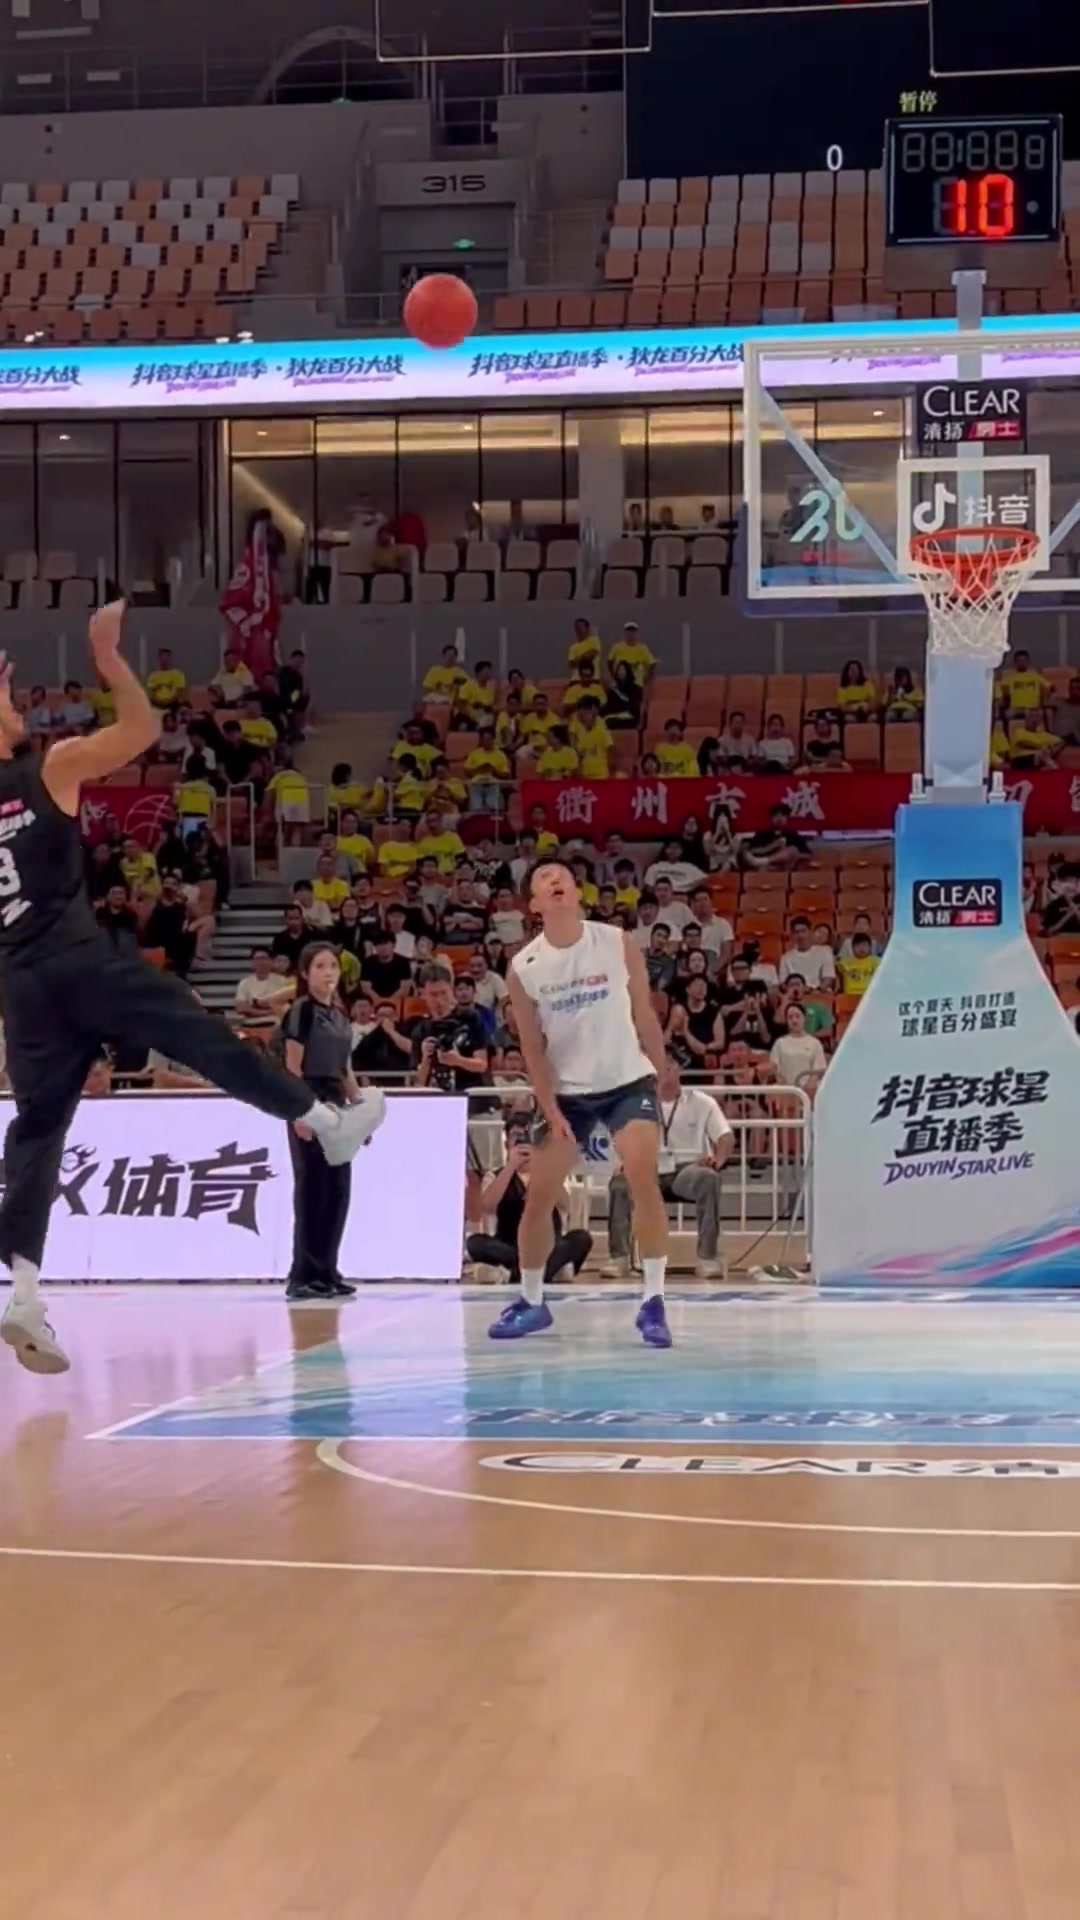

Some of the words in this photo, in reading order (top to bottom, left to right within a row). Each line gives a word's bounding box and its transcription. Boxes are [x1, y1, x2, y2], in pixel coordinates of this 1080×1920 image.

[899, 90, 938, 113] 暂停
[826, 144, 844, 171] 0
[421, 173, 487, 194] 315
[957, 173, 1014, 236] 10
[922, 385, 1020, 417] CLEAR
[923, 420, 965, 441] 清扬
[964, 493, 1030, 525] 抖音
[918, 881, 996, 908] CLEAR
[898, 996, 953, 1017] 这个夏天
[960, 991, 1015, 1011] 抖音打造
[901, 1008, 1017, 1037] 球星百分盛宴
[870, 1066, 1051, 1125] 抖音球星
[893, 1111, 1024, 1159] 直播季
[883, 1157, 957, 1186] DOUYIN
